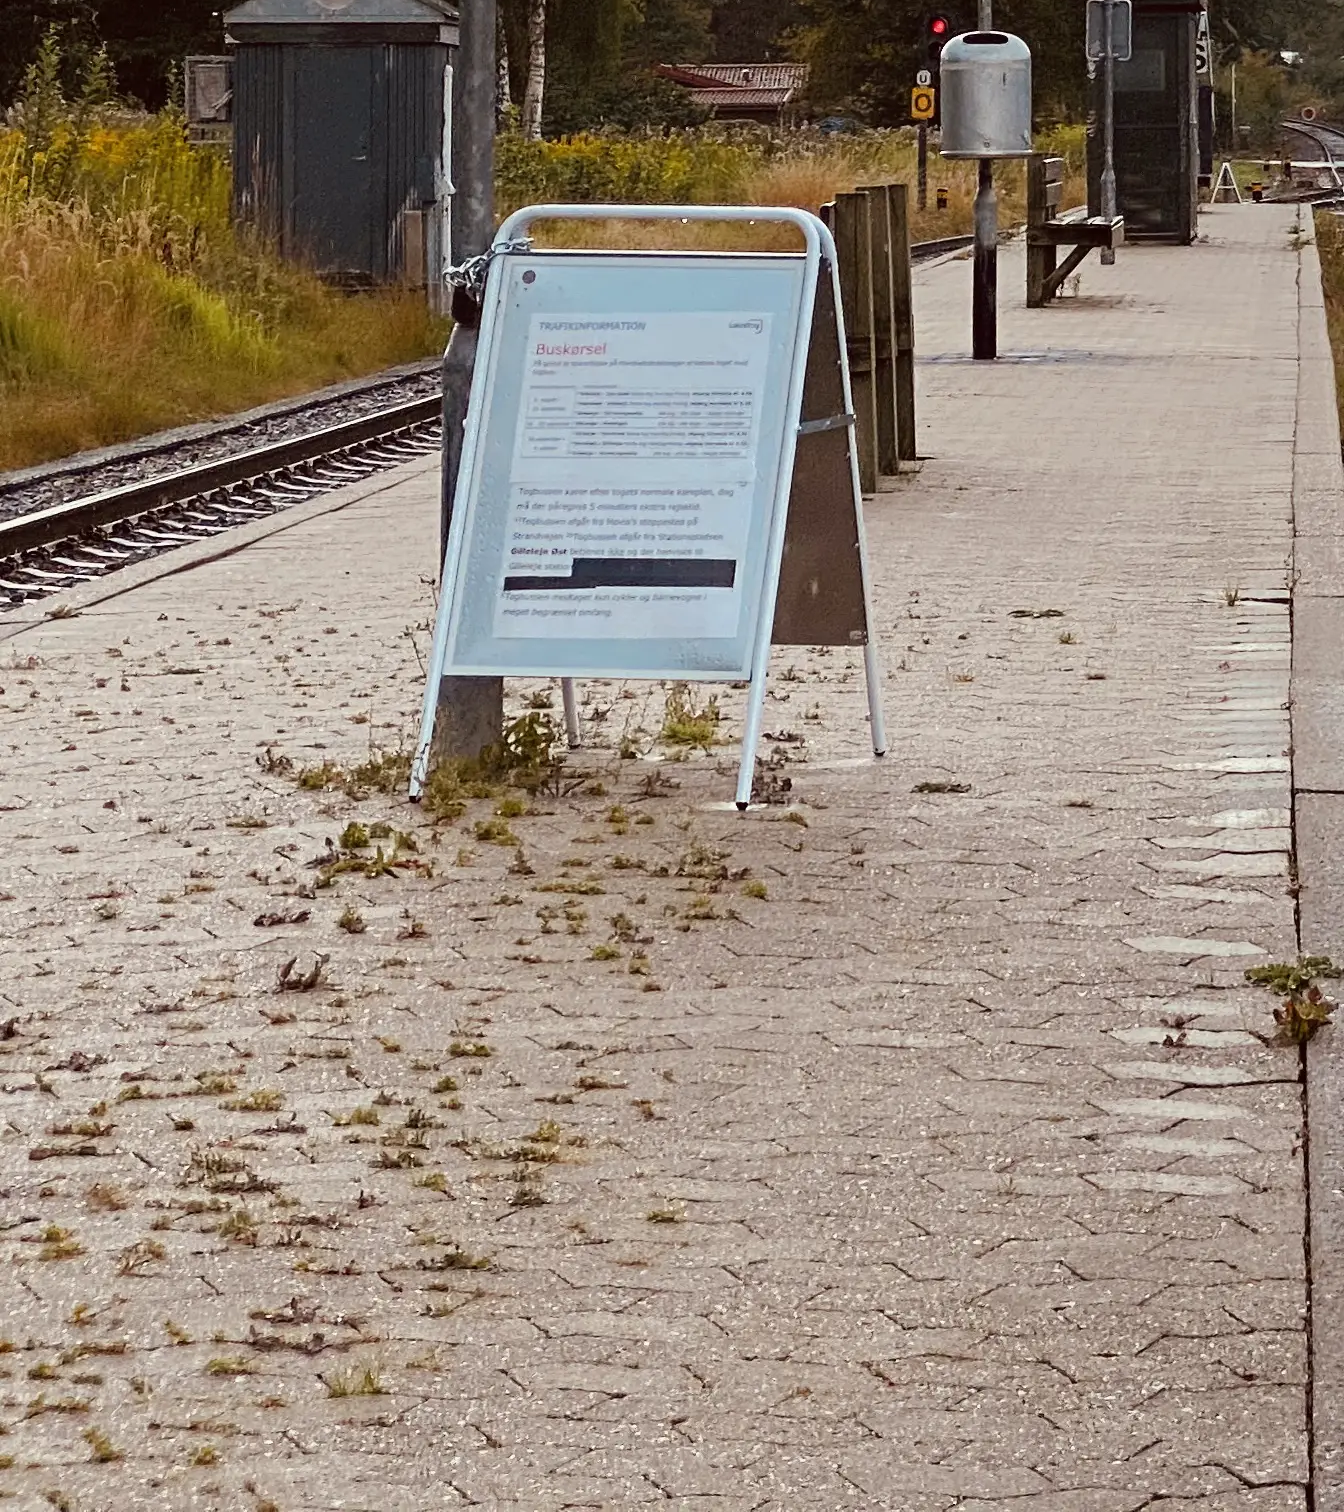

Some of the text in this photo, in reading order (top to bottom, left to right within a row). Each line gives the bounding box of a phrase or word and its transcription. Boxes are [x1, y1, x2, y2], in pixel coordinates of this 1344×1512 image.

[919, 74, 927, 83] U
[539, 321, 647, 331] TRAFIKINFORMATION
[536, 343, 607, 356] Buskørsel
